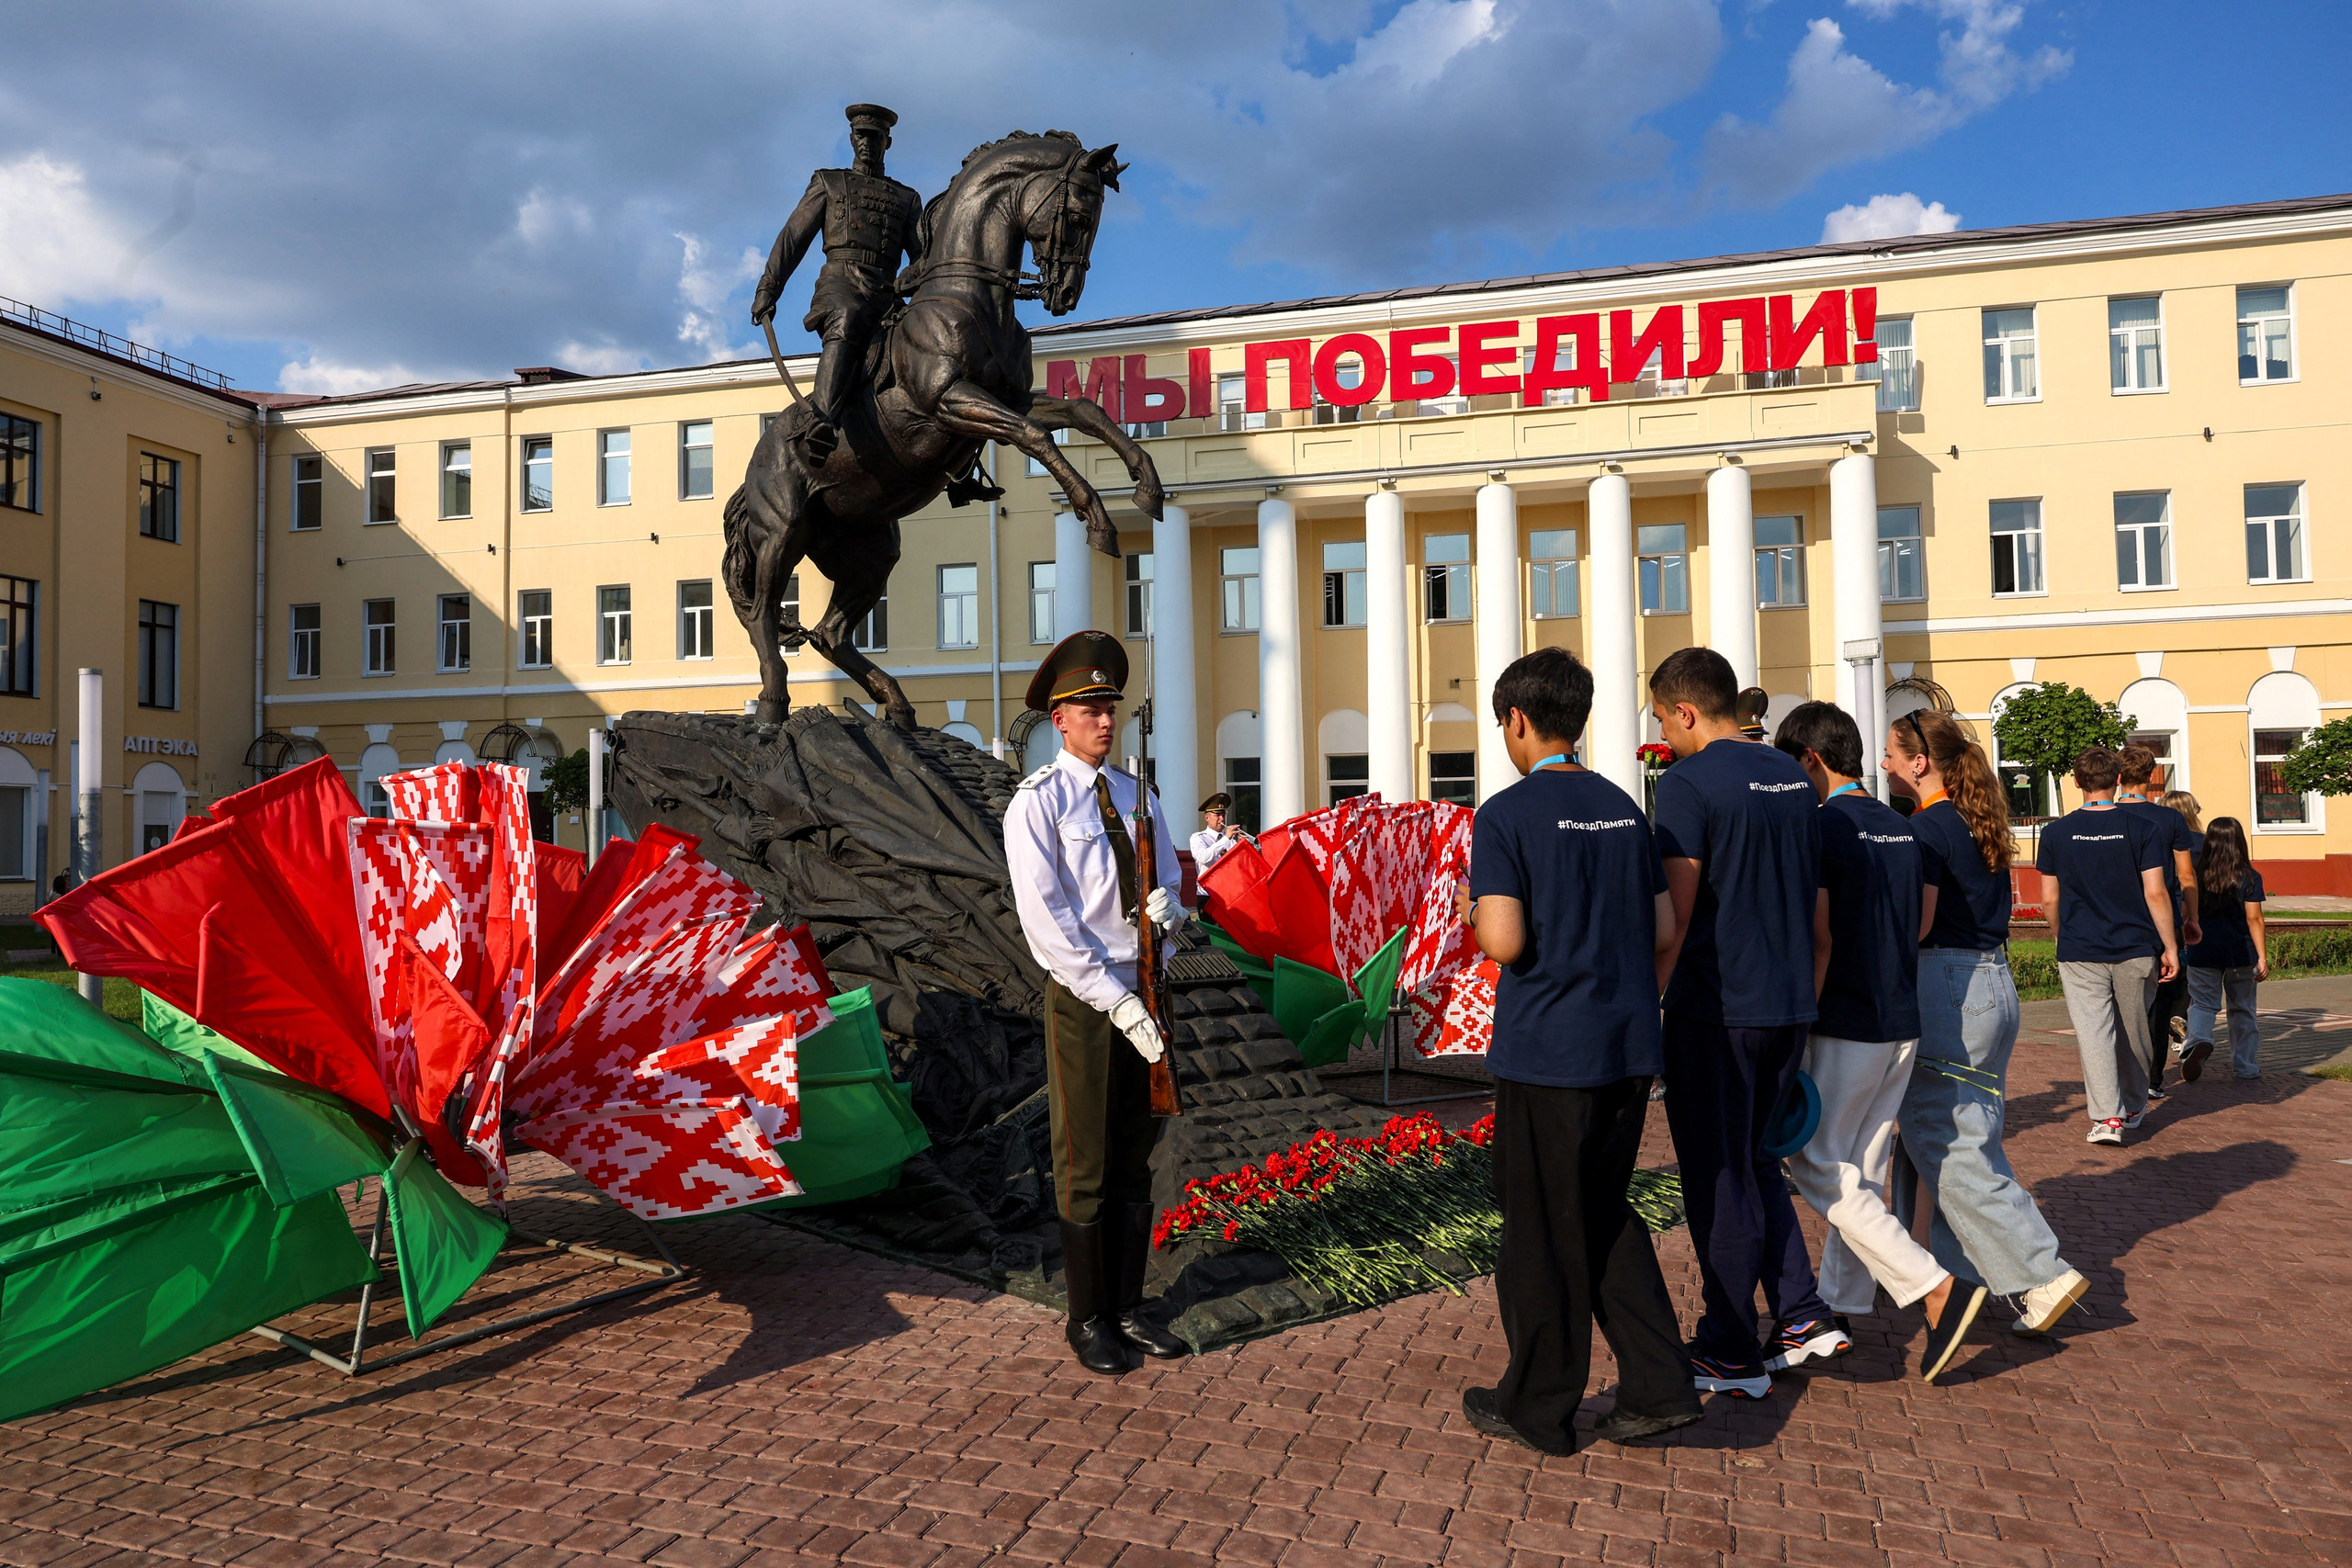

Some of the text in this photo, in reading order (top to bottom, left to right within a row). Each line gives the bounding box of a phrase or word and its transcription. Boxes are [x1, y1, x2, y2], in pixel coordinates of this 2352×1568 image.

[1046, 286, 1878, 424] МЫ ПОБЕДИЛИ!
[20, 728, 57, 746] лекі
[124, 735, 198, 757] АПТЭКА
[1748, 782, 1809, 793] #ПоездПамяти
[1557, 818, 1636, 831] #ПоездПамяти
[1857, 830, 1914, 843] #здПамяти
